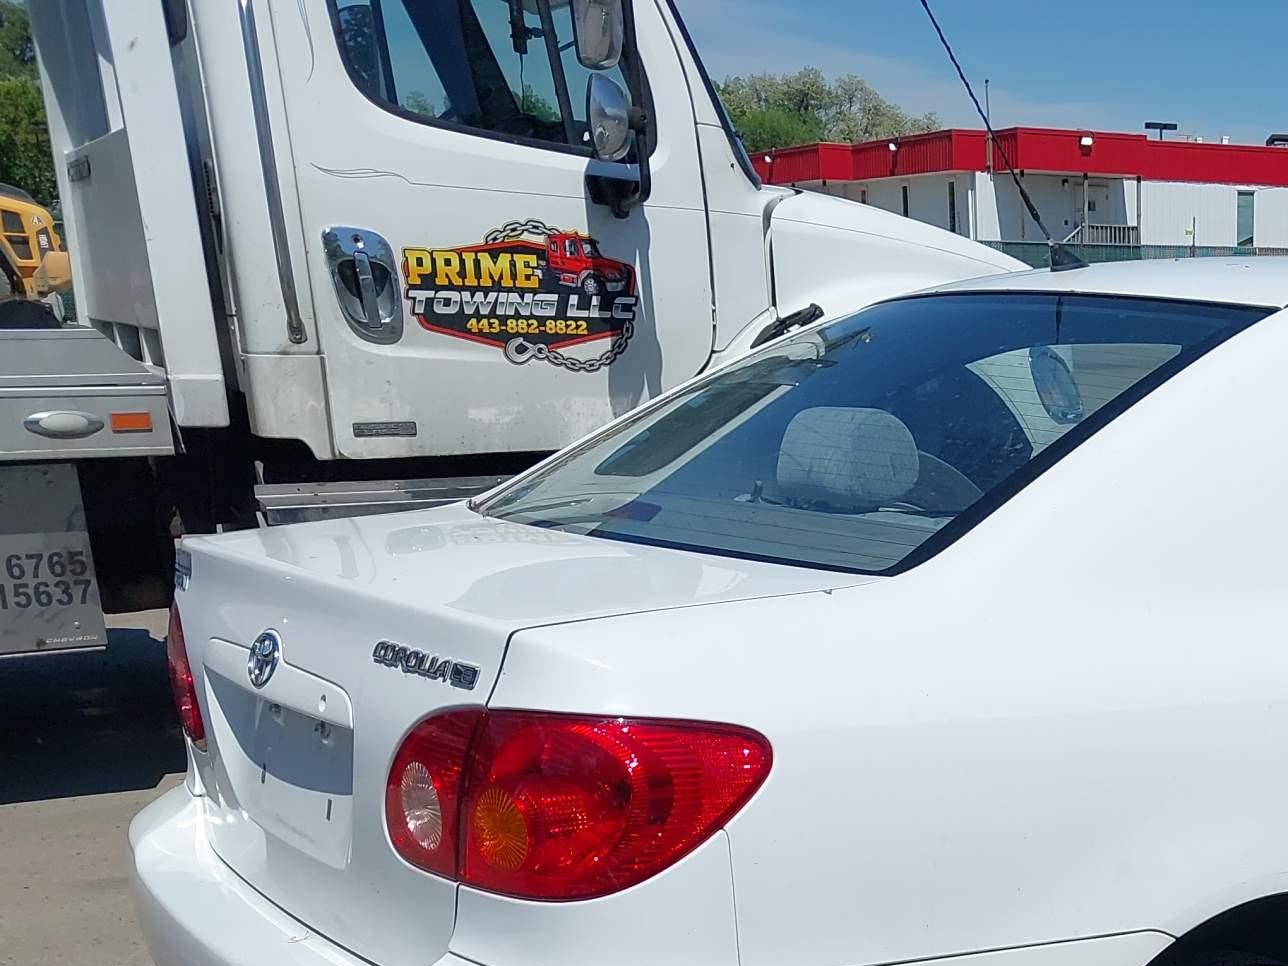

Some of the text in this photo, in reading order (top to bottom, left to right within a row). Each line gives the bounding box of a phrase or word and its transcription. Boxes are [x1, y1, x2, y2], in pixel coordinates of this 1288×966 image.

[405, 250, 539, 289] PRIME
[407, 291, 637, 319] TOWING LLC
[466, 318, 588, 335] 443-882-8822
[5, 551, 88, 580] 6765
[373, 640, 451, 682] COROLLA
